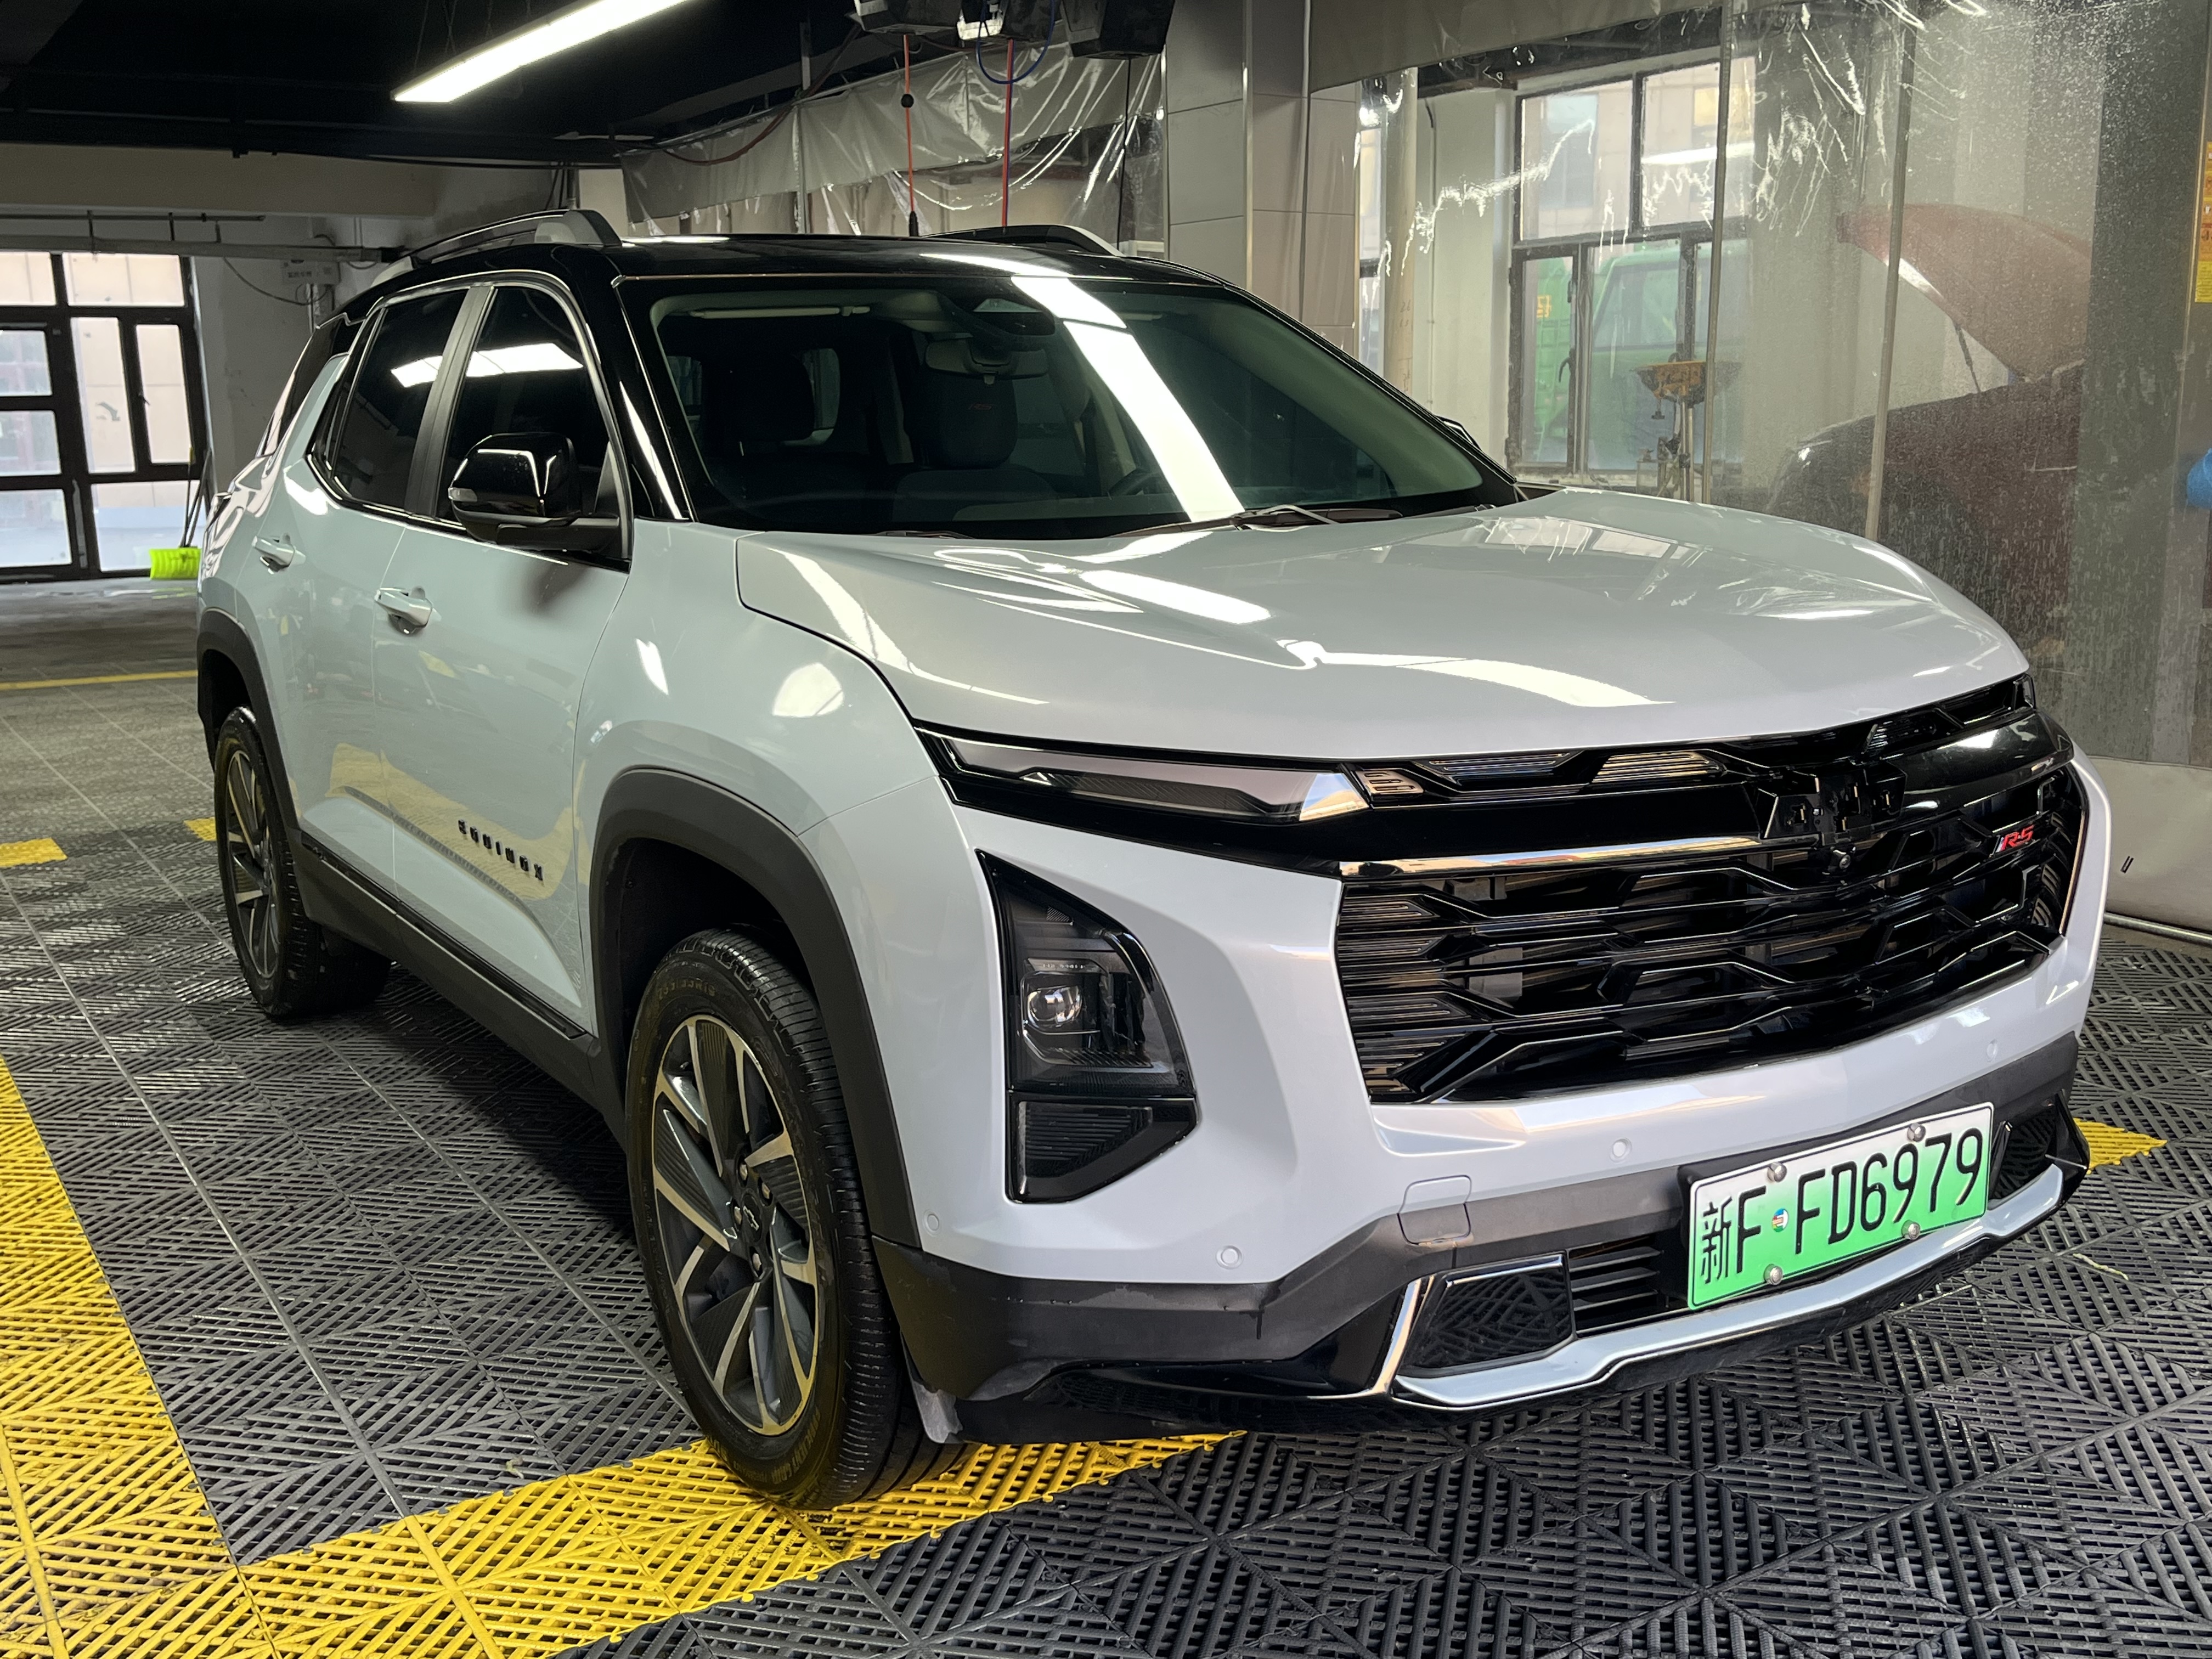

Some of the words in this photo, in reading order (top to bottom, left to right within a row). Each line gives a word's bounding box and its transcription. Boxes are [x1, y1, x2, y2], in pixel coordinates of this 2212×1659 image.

[458, 819, 543, 881] EQUINOX
[1997, 825, 2035, 852] RS
[1795, 1127, 1983, 1255] FD6979
